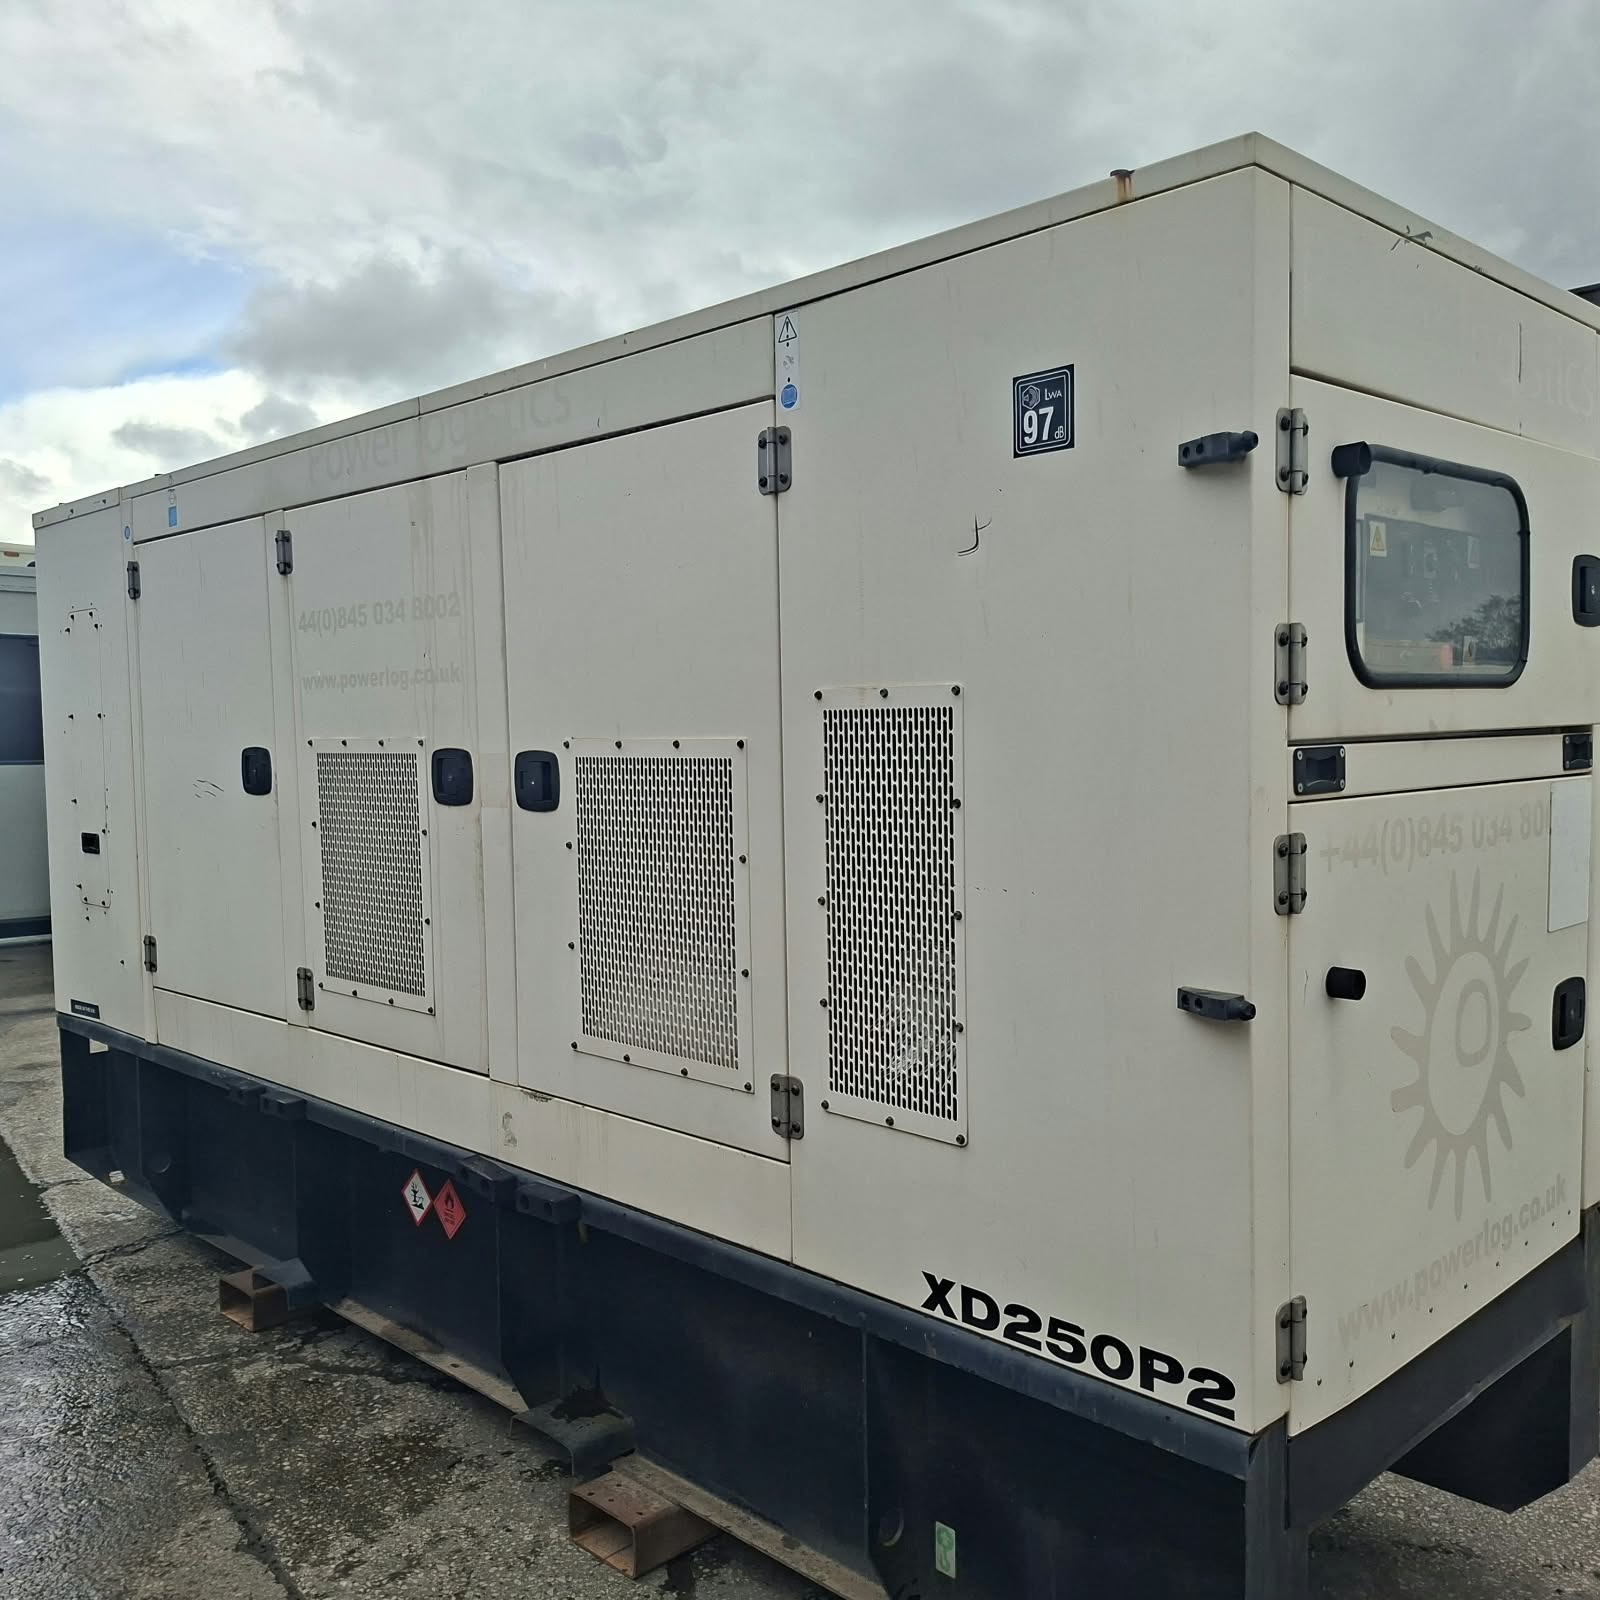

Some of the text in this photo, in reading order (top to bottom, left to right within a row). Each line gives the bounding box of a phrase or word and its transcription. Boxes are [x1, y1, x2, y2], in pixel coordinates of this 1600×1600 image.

[1023, 406, 1065, 444] 97 dB
[372, 598, 406, 625] 034
[302, 661, 462, 694] www.powerlog.co.uk
[1319, 800, 1550, 877] +44(0)845 034 80
[1337, 1173, 1566, 1349] www.powerlog.co.uk
[921, 1270, 1236, 1421] XD250P2
